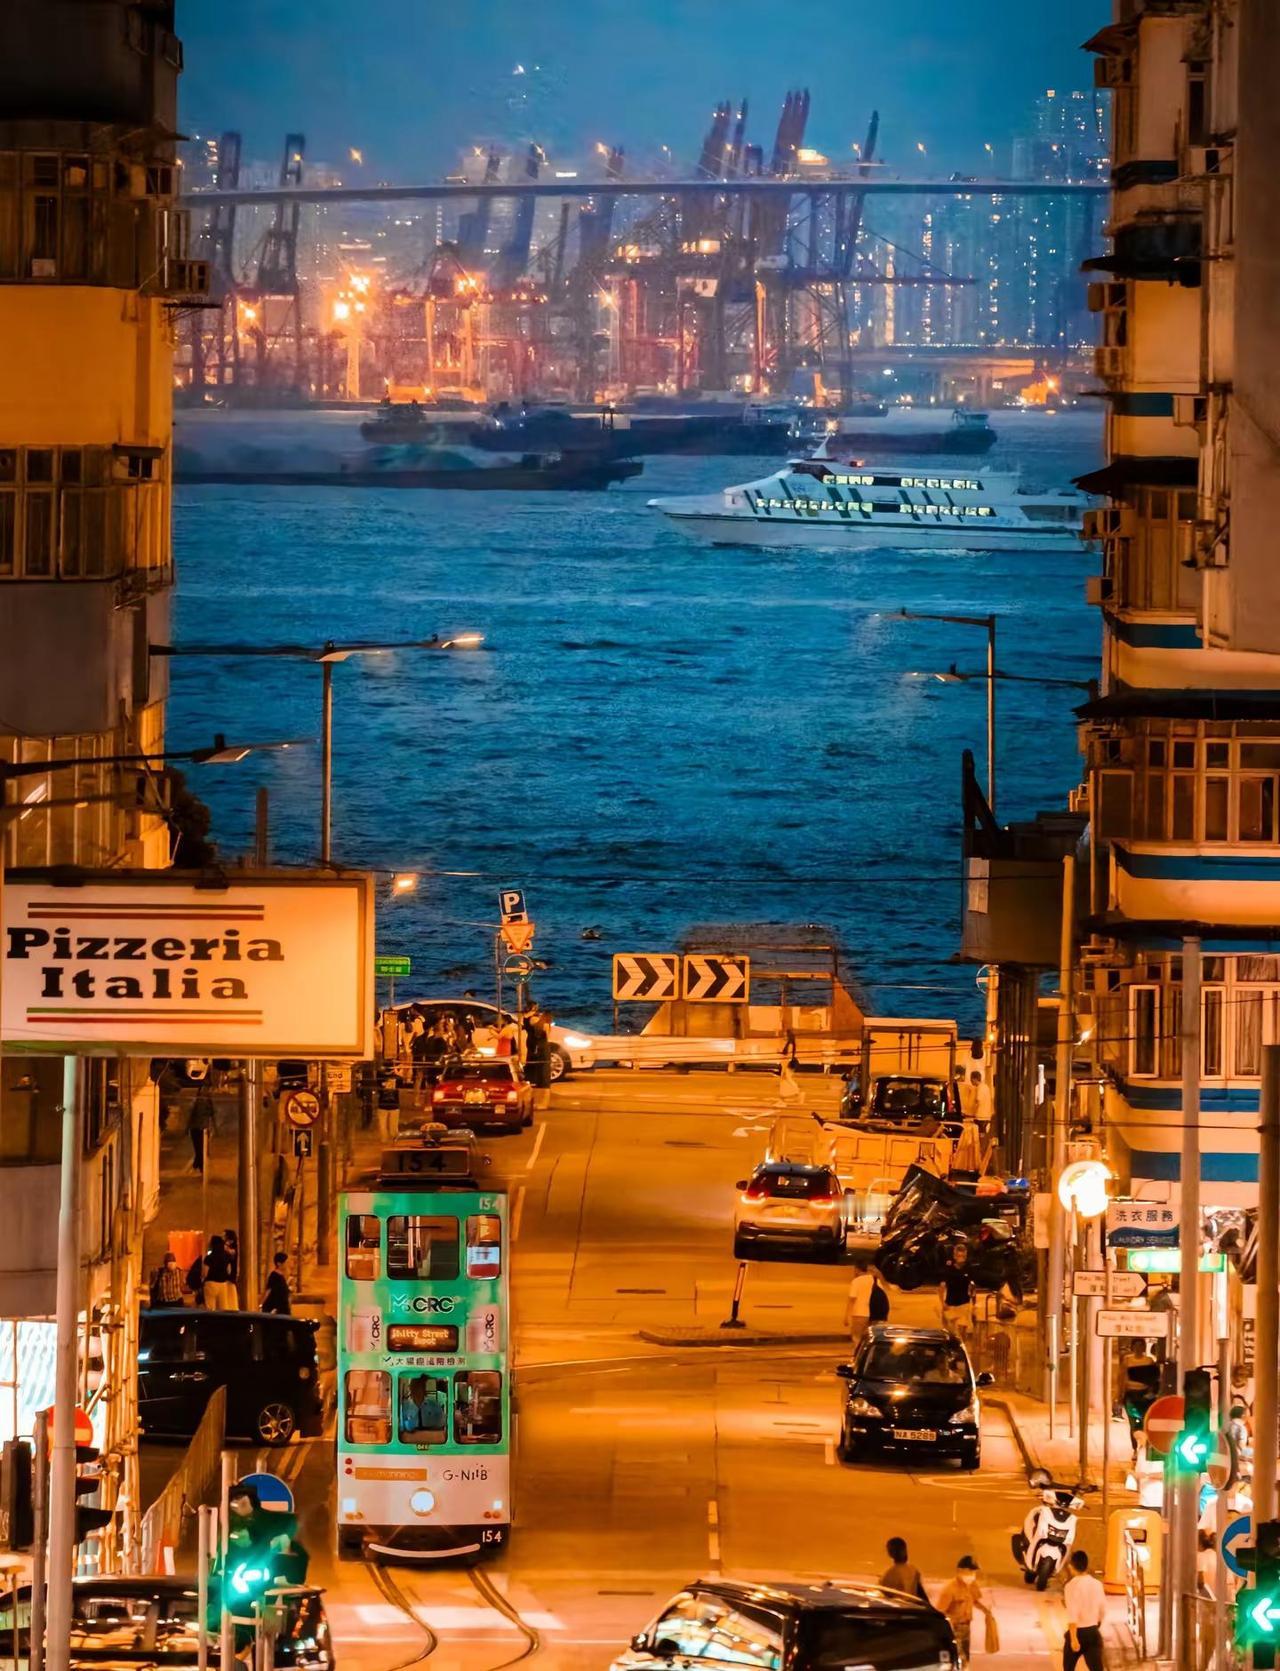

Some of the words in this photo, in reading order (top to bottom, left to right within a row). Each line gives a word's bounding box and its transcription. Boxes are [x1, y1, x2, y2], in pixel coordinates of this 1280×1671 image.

[503, 893, 520, 913] P
[7, 928, 285, 962] Pizzeria
[41, 967, 249, 999] Italia
[398, 1152, 447, 1172] 154
[1115, 1210, 1174, 1222] 洗衣服務
[413, 1296, 455, 1313] CRC
[482, 1530, 502, 1543] 154
